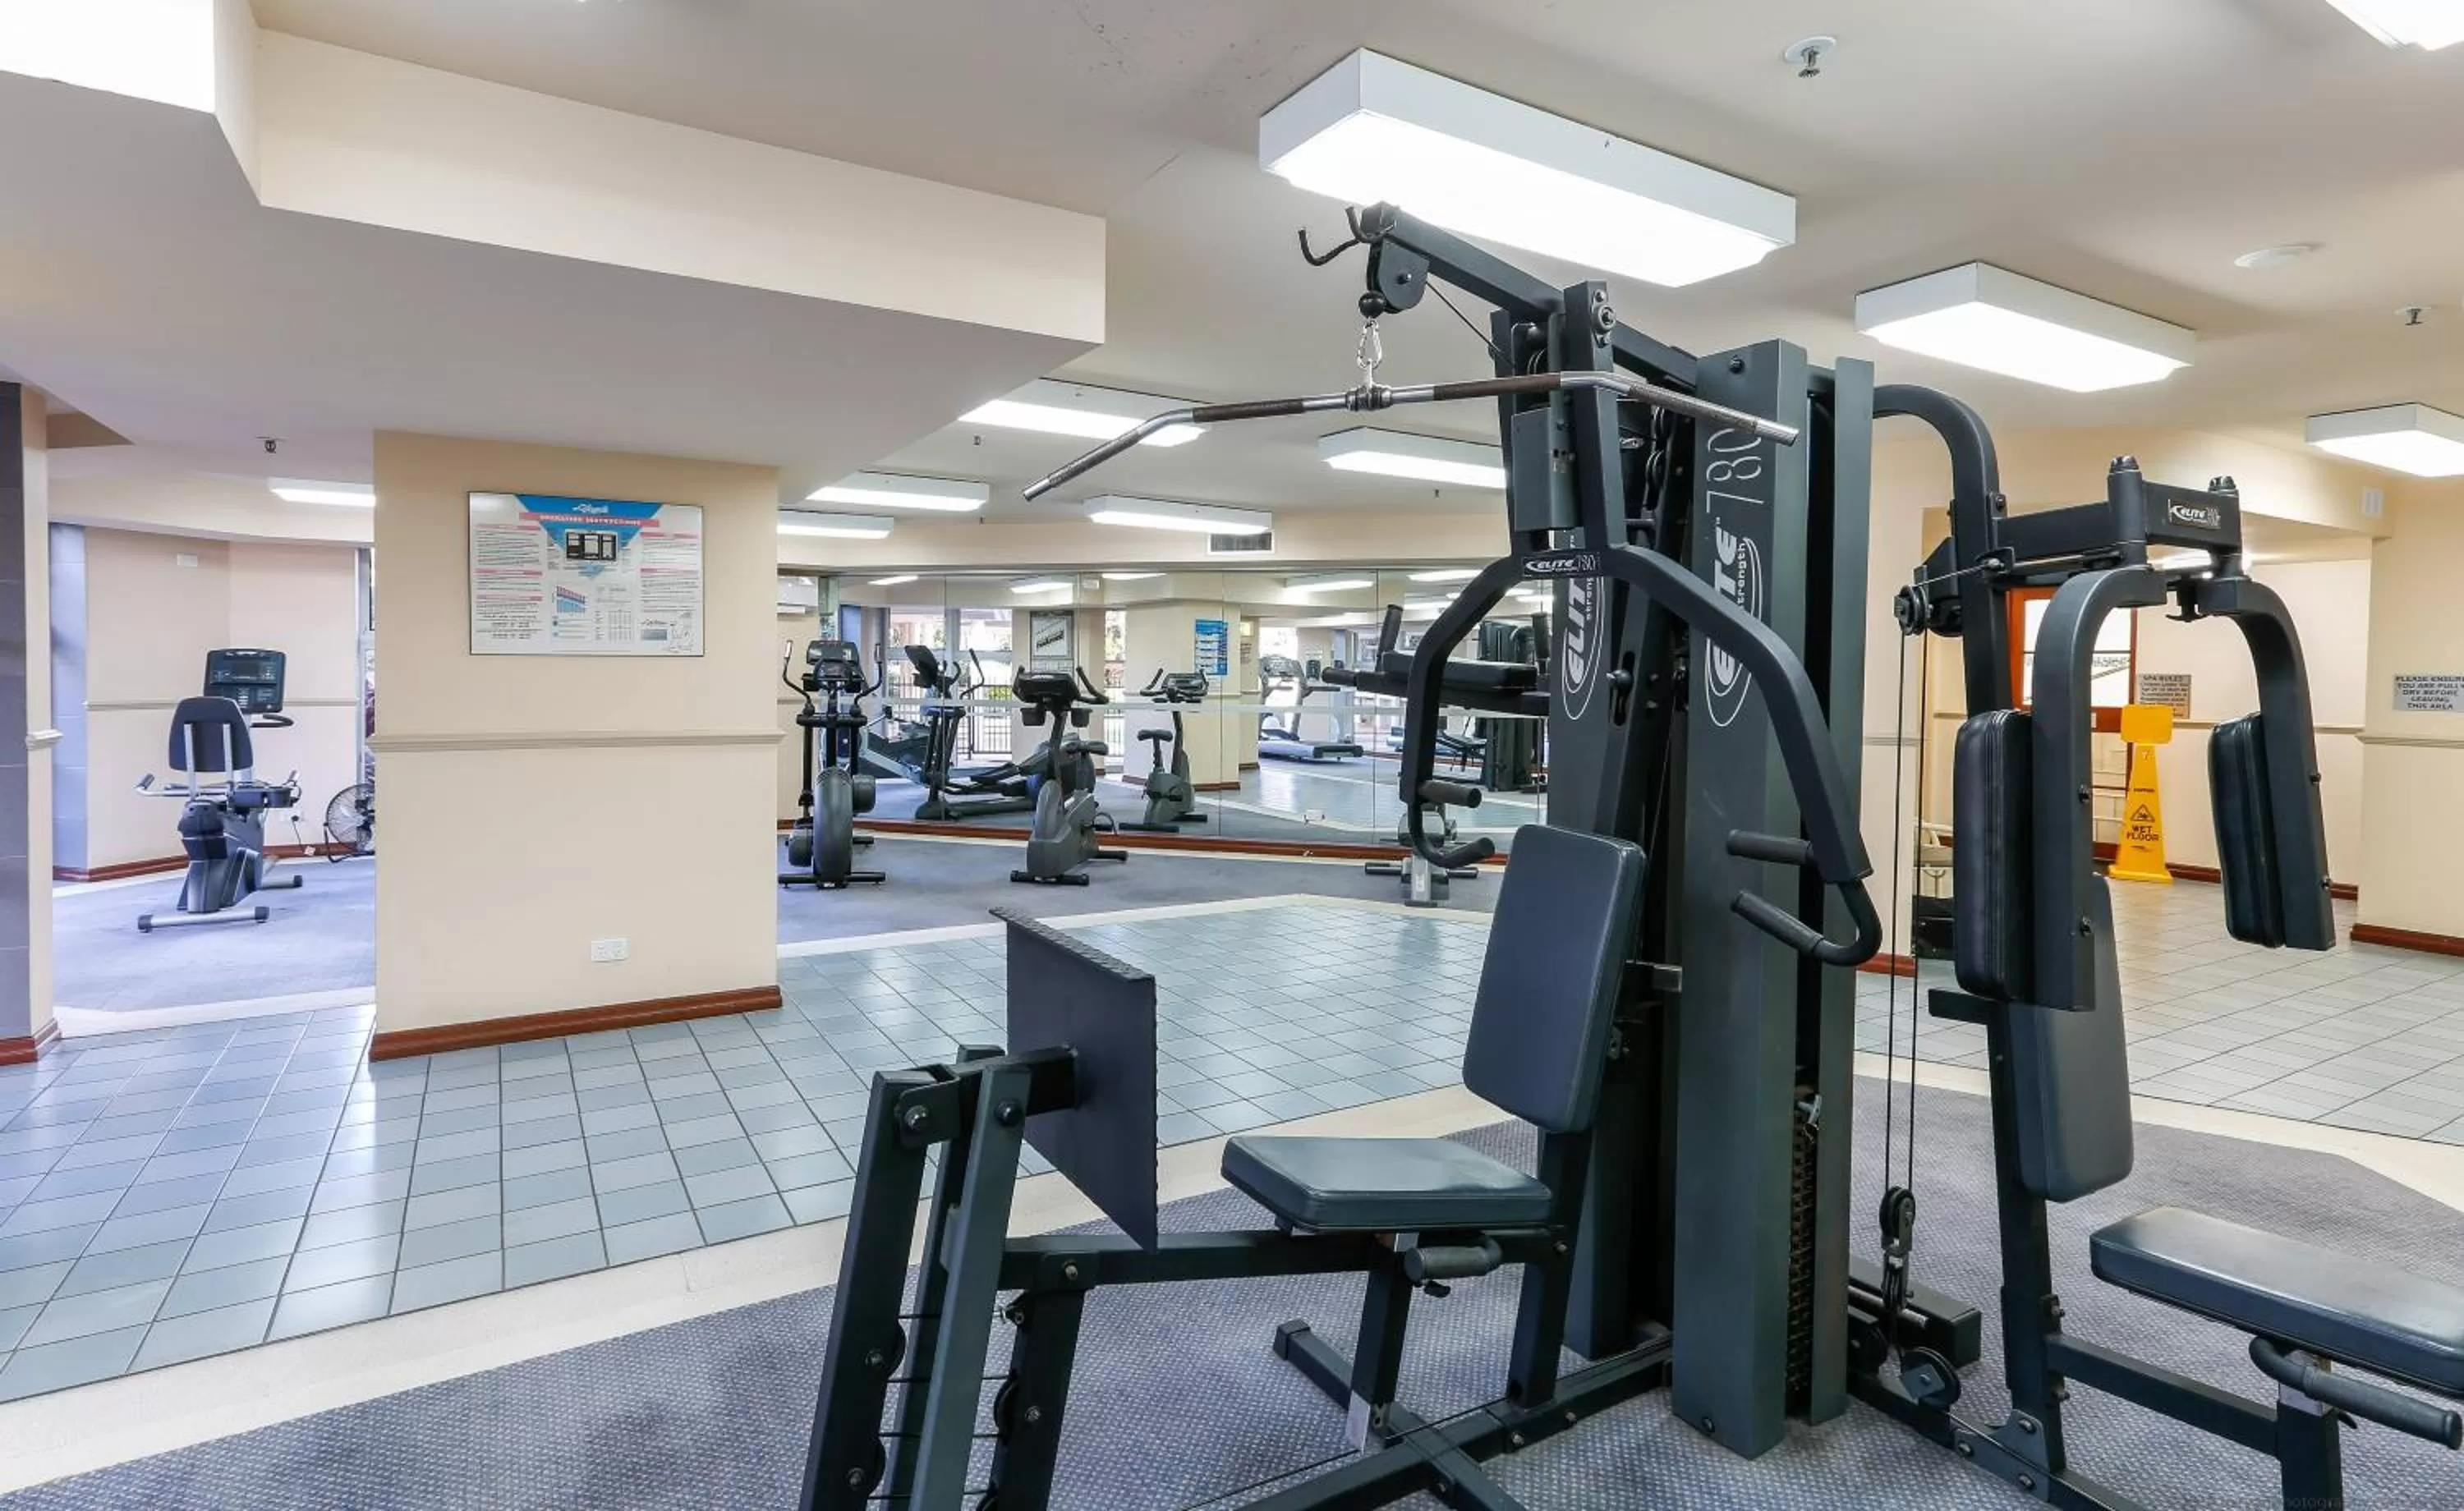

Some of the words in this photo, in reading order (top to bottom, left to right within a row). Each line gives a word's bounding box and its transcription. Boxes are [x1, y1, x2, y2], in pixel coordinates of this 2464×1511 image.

[1706, 428, 1764, 513] 780
[1568, 567, 1586, 685] ELIT
[1714, 526, 1738, 686] ETE
[2126, 832, 2159, 842] FLOOR
[2131, 825, 2154, 834] WET
